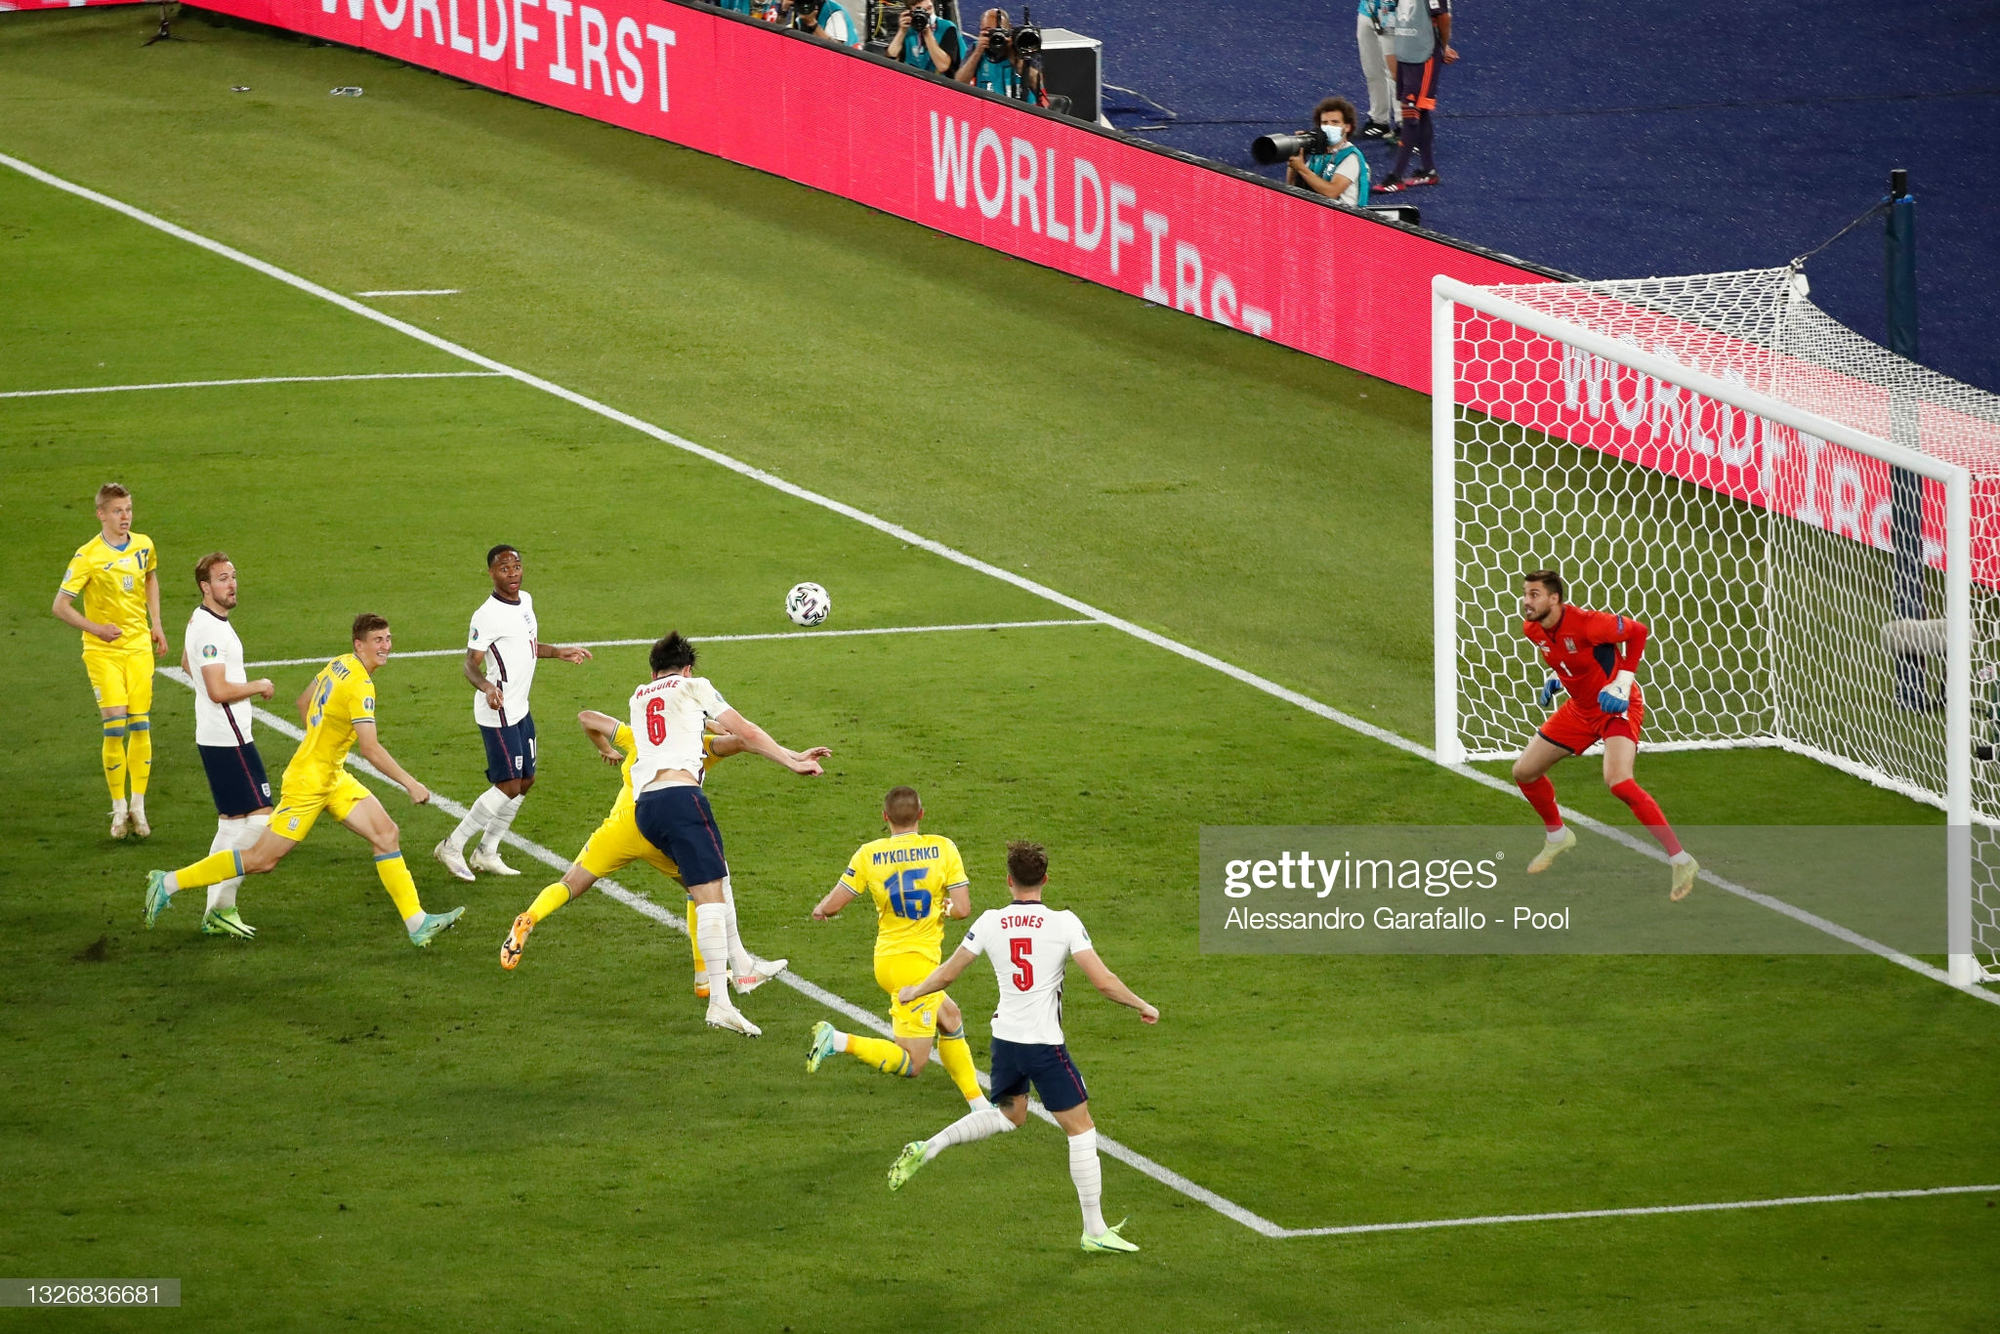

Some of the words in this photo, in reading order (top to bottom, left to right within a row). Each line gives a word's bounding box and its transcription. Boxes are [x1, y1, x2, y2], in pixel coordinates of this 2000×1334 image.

[135, 548, 150, 570] 17
[1559, 661, 1573, 677] 1
[646, 697, 667, 746] 6
[873, 846, 939, 866] MYKOLENKO
[884, 867, 933, 921] 16
[1000, 915, 1044, 930] STONES
[1009, 937, 1034, 991] 5
